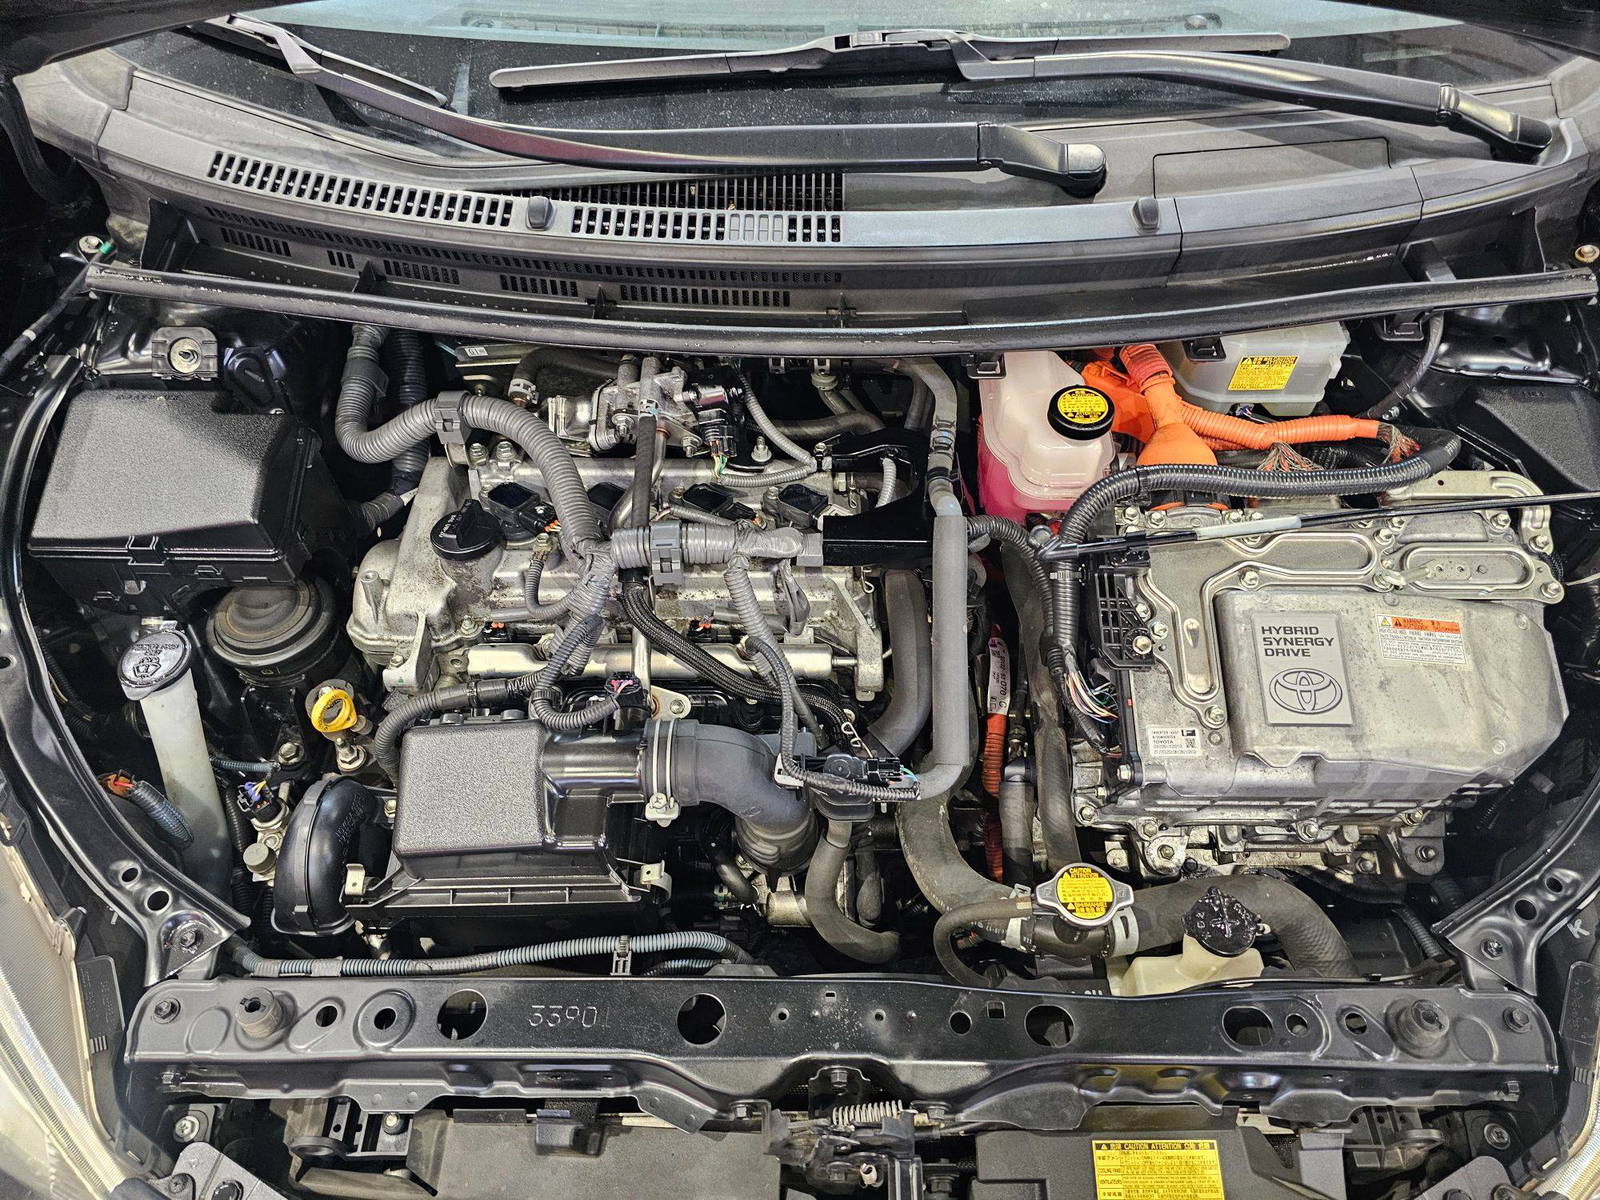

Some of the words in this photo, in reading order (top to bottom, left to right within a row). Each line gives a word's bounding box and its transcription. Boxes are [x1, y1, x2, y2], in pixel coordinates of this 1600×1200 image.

[1261, 626, 1319, 635] HYBRID
[1263, 637, 1334, 646] SYNERGY
[1264, 648, 1311, 657] DRIVE
